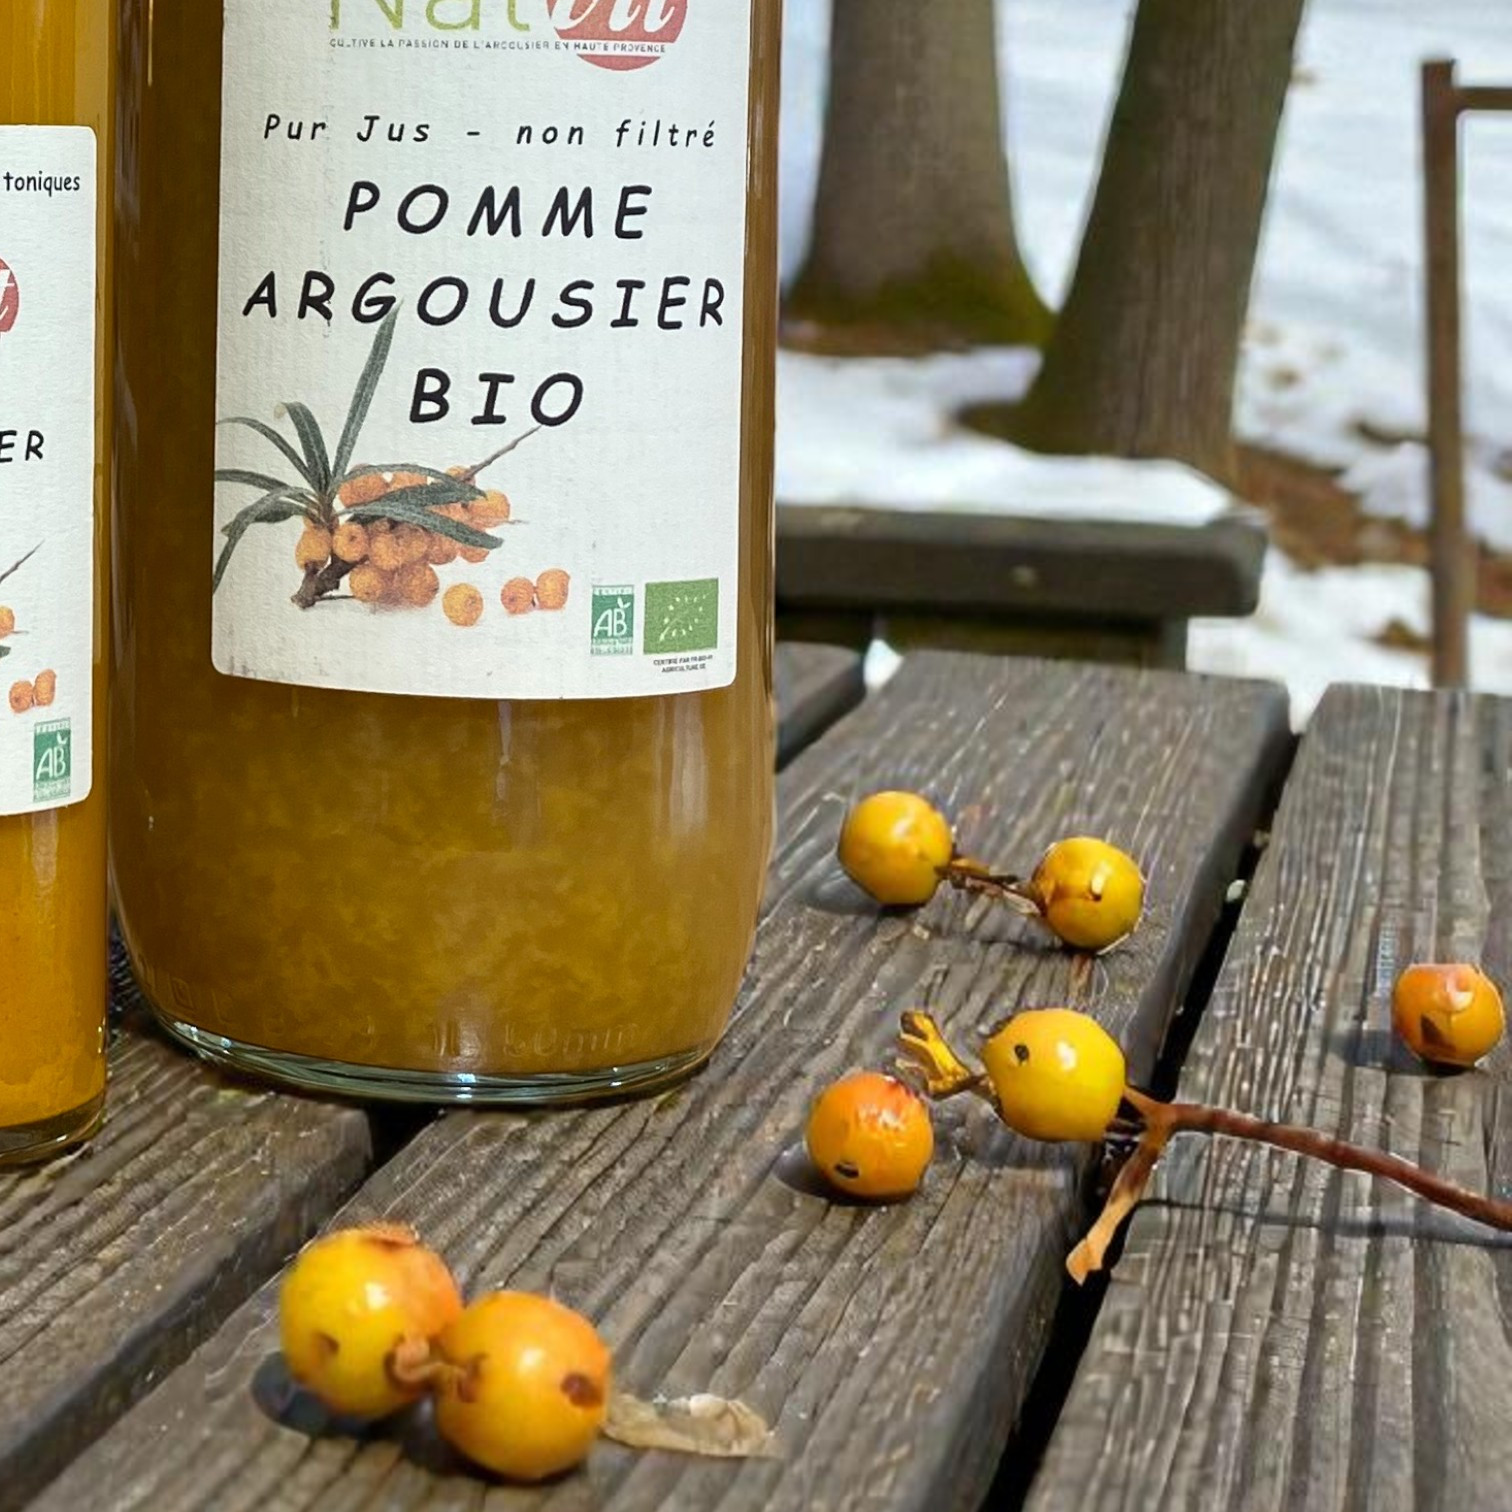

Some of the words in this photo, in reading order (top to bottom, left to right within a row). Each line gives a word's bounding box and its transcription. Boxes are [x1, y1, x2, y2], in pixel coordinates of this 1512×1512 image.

[263, 113, 328, 141] Pur
[356, 115, 431, 143] Jus
[516, 125, 585, 146] non
[615, 117, 716, 148] filtré
[2, 170, 81, 198] toniques
[343, 180, 653, 240] POMME
[242, 269, 726, 330] ARGOUSIER
[409, 367, 584, 427] BIO
[593, 607, 628, 637] AB
[35, 746, 66, 780] AB
